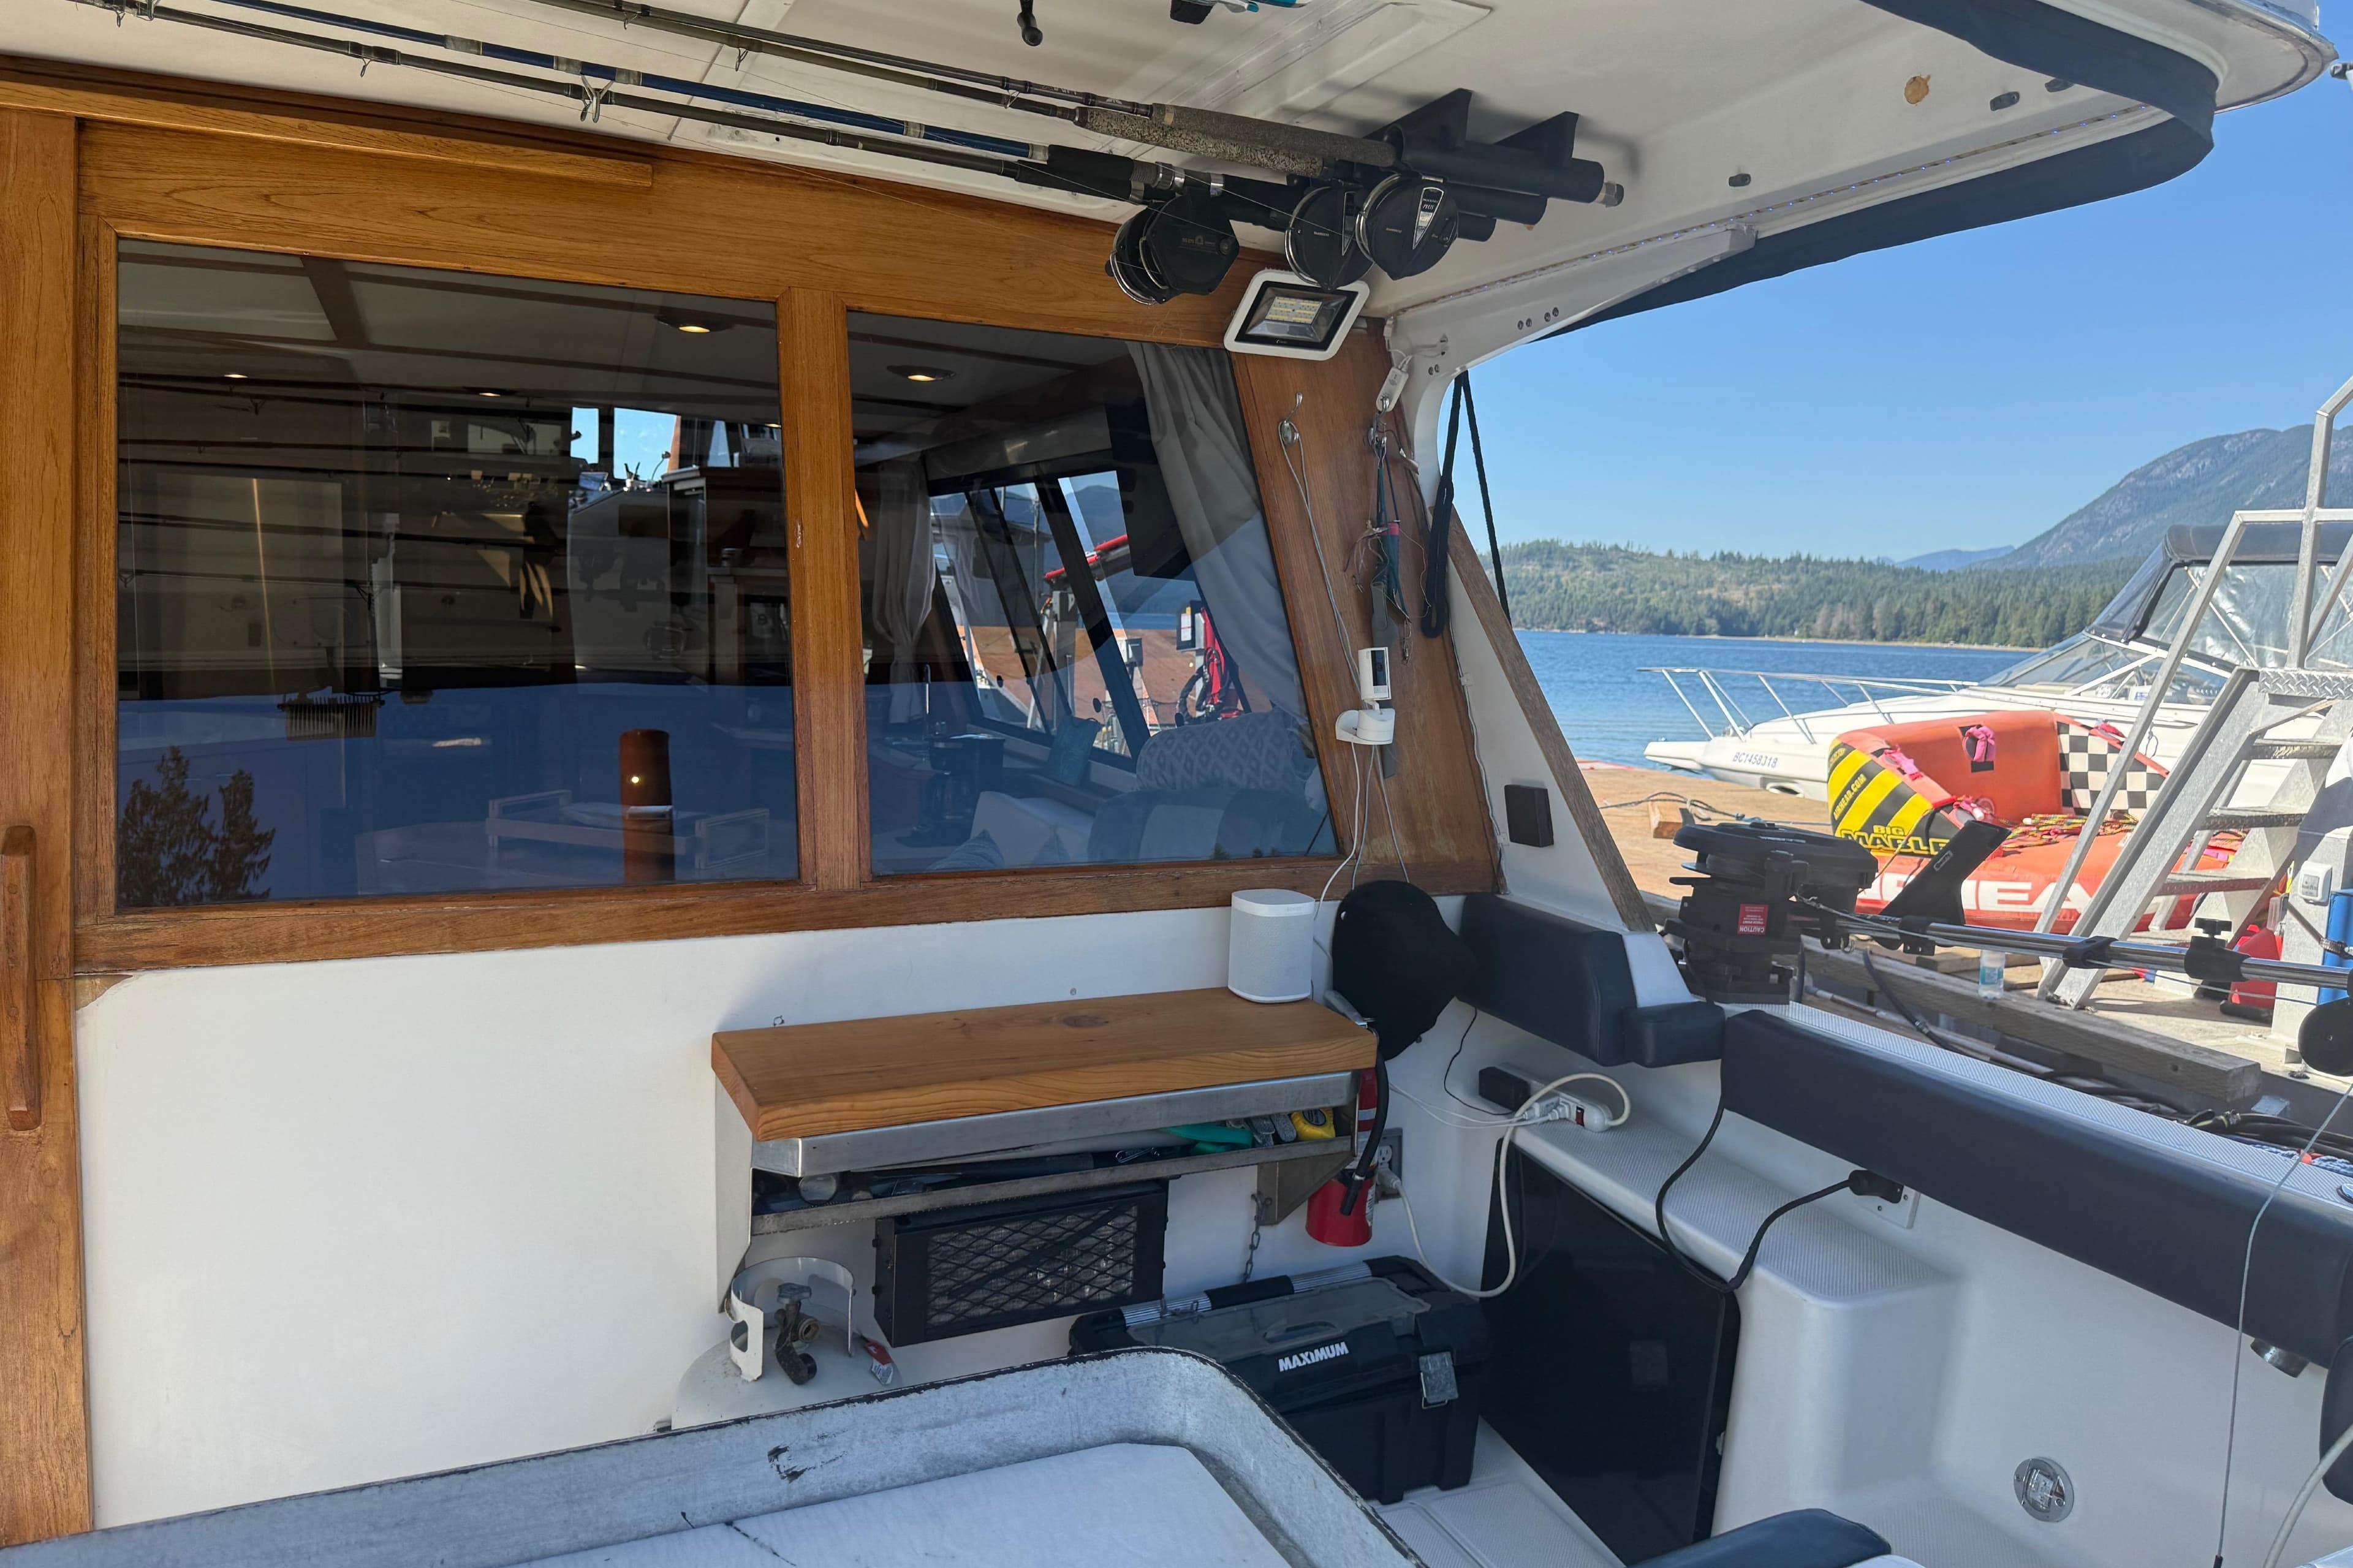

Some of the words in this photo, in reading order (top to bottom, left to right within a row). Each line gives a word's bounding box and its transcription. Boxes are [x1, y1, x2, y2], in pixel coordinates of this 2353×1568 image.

[1732, 752, 1778, 768] BC1458318
[1833, 773, 1866, 820] AIRHEAD.COM
[1873, 825, 1905, 836] BIG
[1278, 1341, 1349, 1372] MAXIMUM
